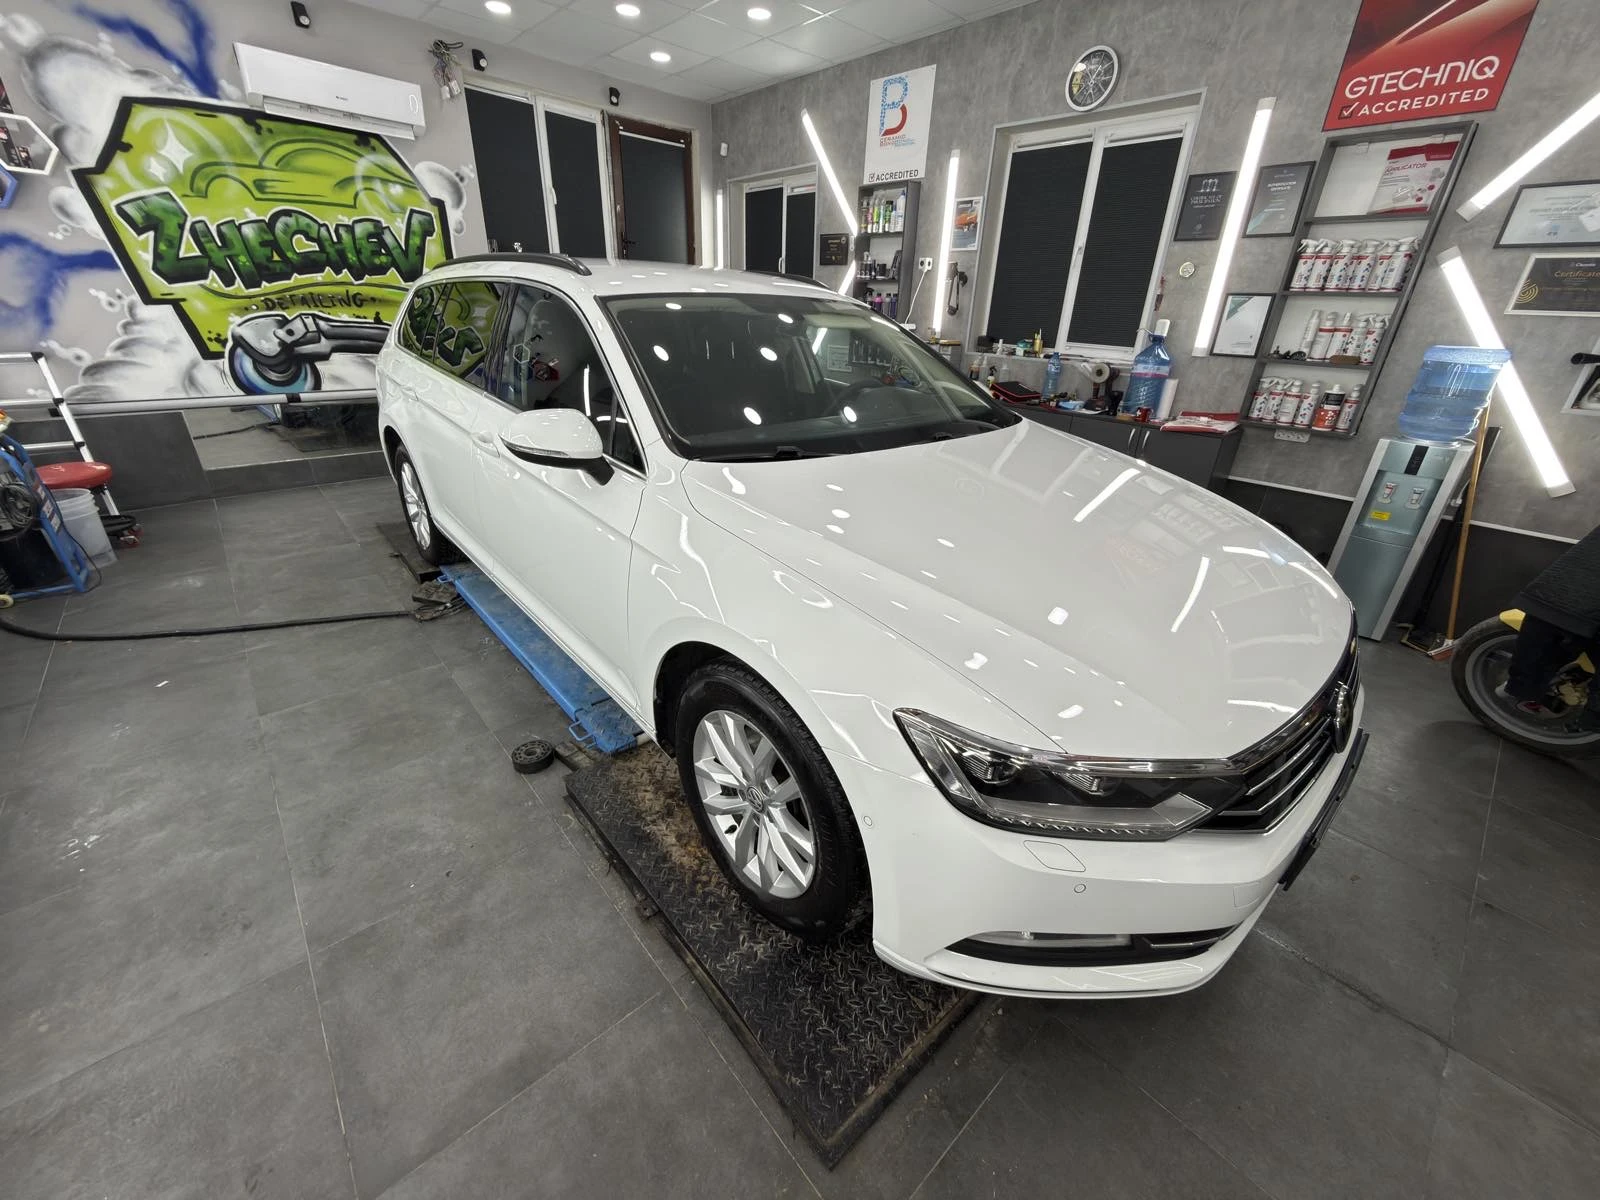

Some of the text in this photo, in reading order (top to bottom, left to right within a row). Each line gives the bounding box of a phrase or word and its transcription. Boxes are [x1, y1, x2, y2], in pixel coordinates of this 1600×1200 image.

[1345, 55, 1500, 99] GTECHNIQ
[1359, 88, 1489, 116] ACCREDITED
[876, 169, 919, 182] ACCREDITED
[1384, 162, 1428, 174] APPLICATOR
[113, 190, 436, 288] ZHECHEV
[263, 289, 366, 310] DETAILING
